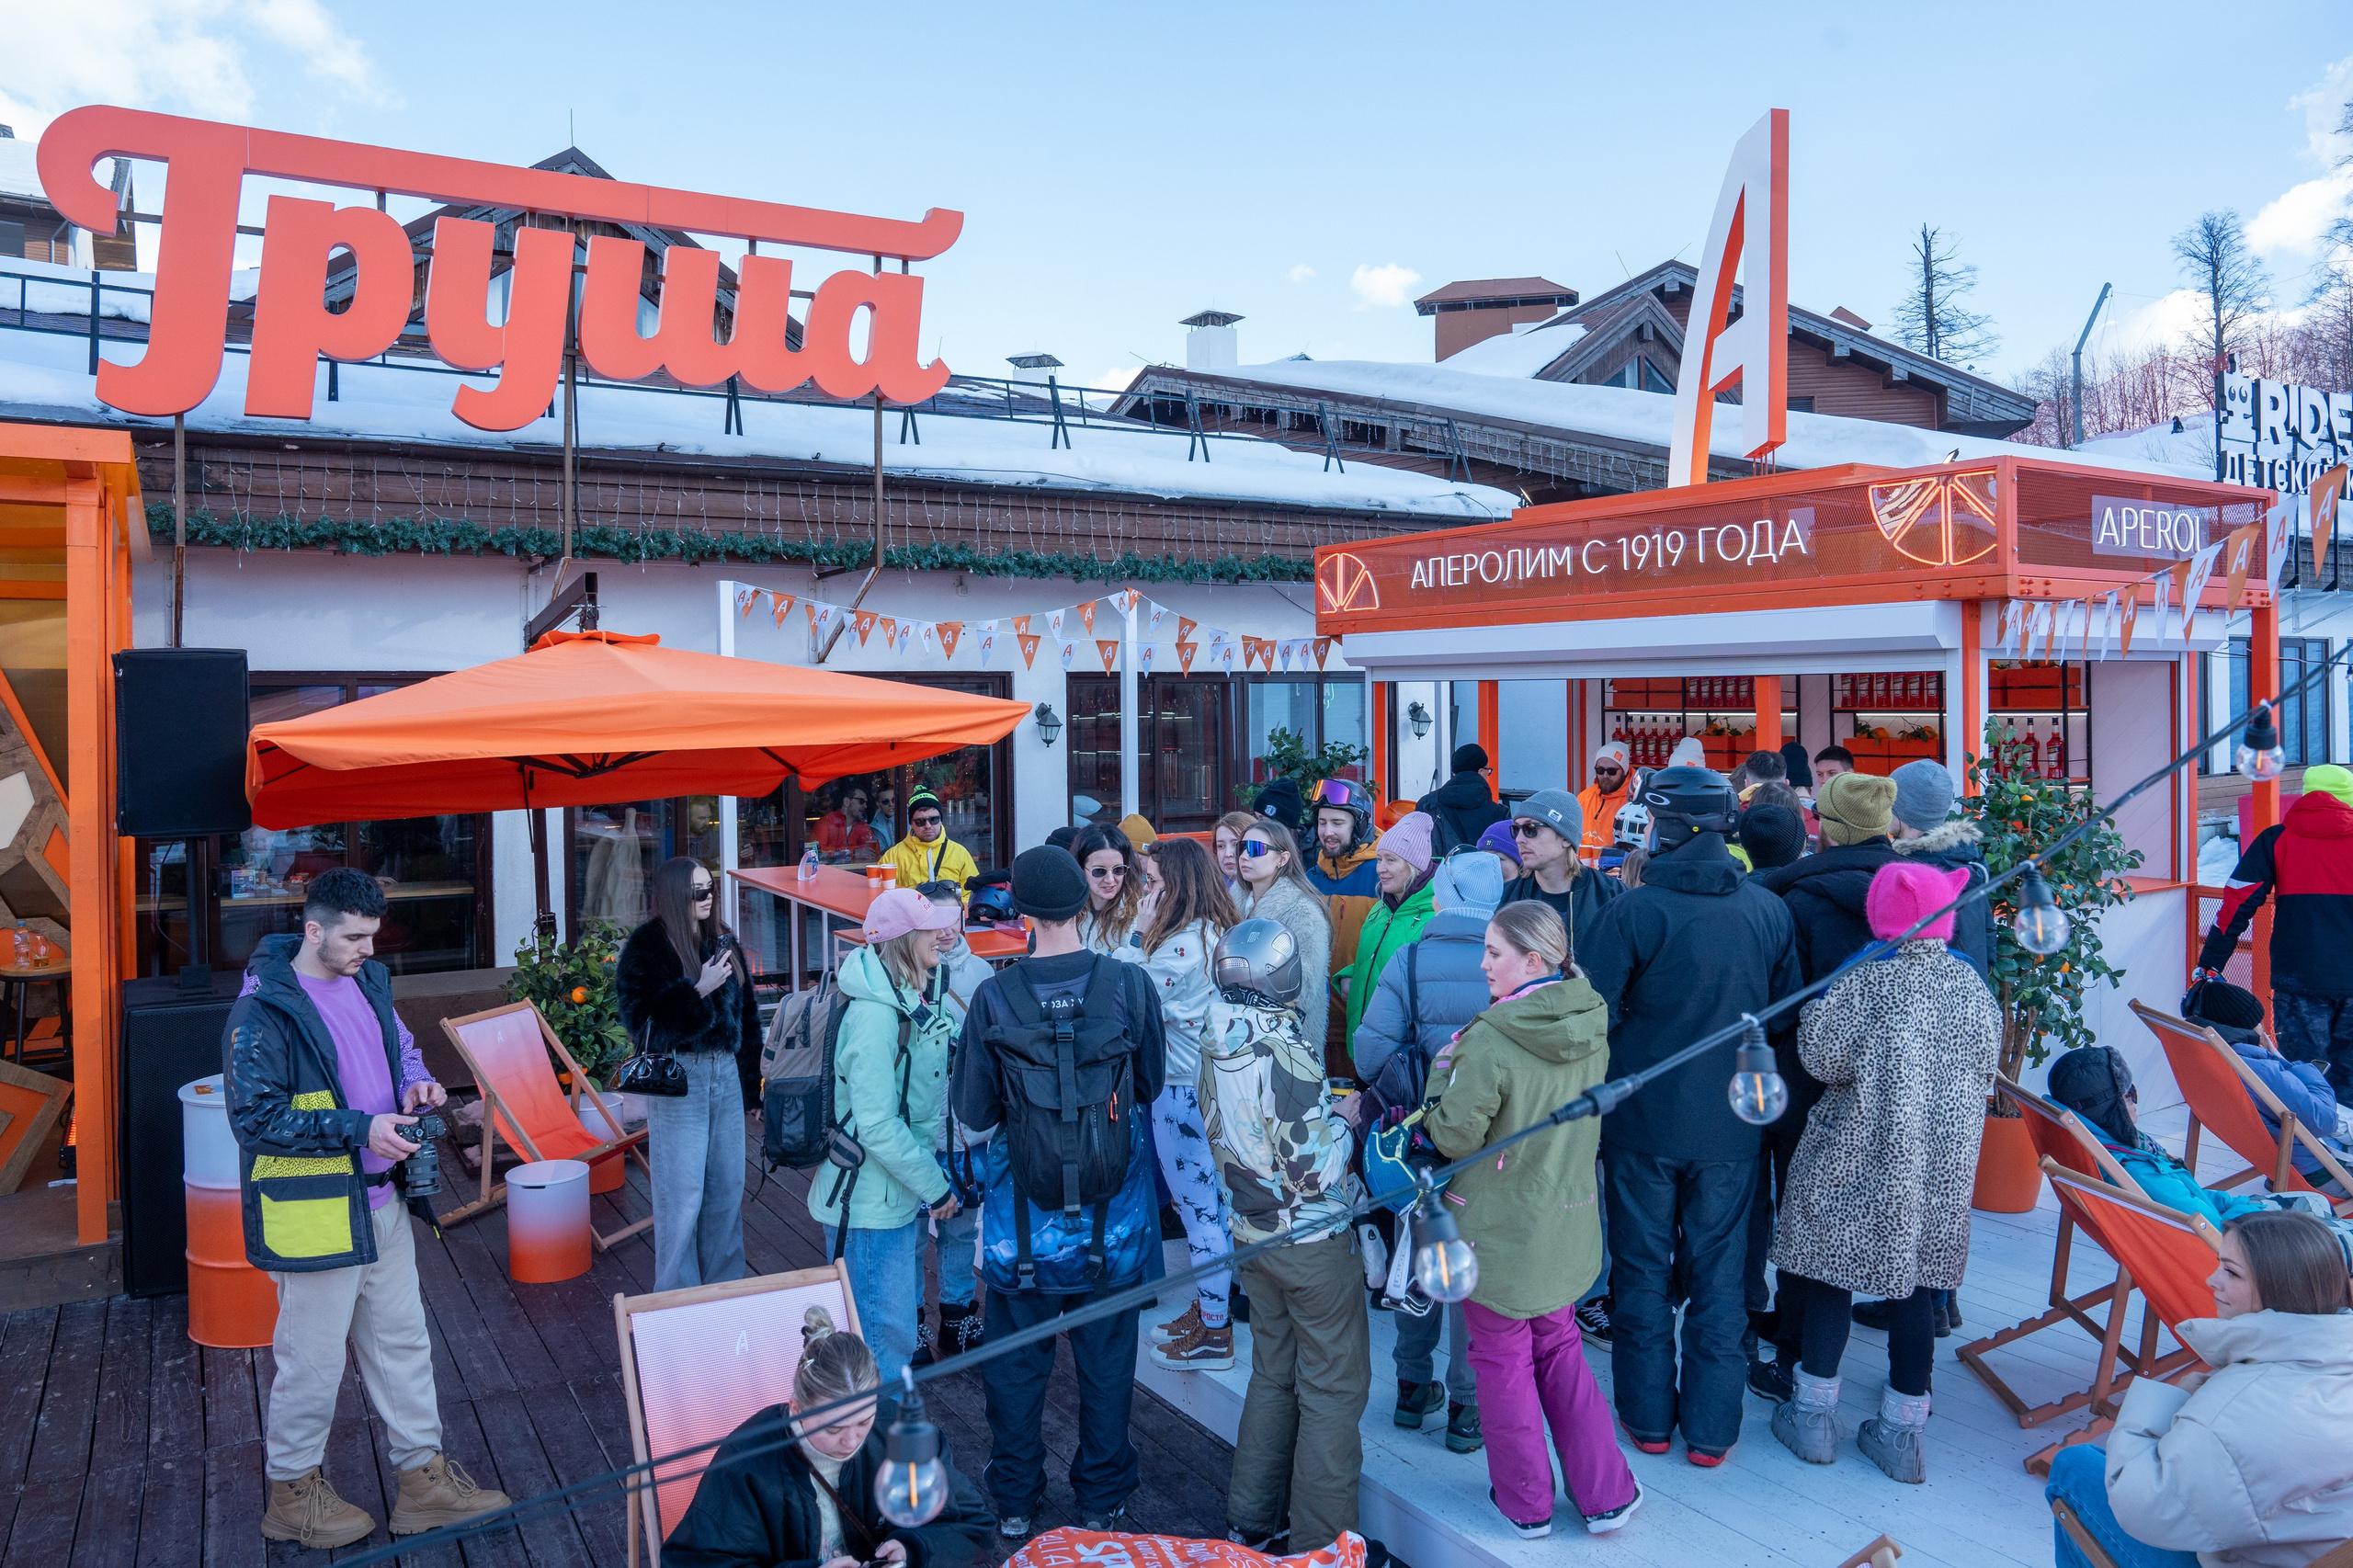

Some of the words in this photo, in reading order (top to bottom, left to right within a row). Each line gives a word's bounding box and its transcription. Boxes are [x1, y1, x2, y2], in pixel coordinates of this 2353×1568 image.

[37, 105, 964, 431] Груша
[2222, 449, 2336, 496] ДЕТСКИ
[2315, 485, 2335, 529] A
[1412, 546, 1573, 589] АПЕРОЛИМ
[1582, 540, 1608, 574] С
[1618, 531, 1685, 570] 1919
[1699, 519, 1808, 564] ГОДА
[2272, 516, 2287, 554] A
[2231, 538, 2248, 574] A
[2122, 596, 2134, 624] A
[735, 1330, 749, 1356] A
